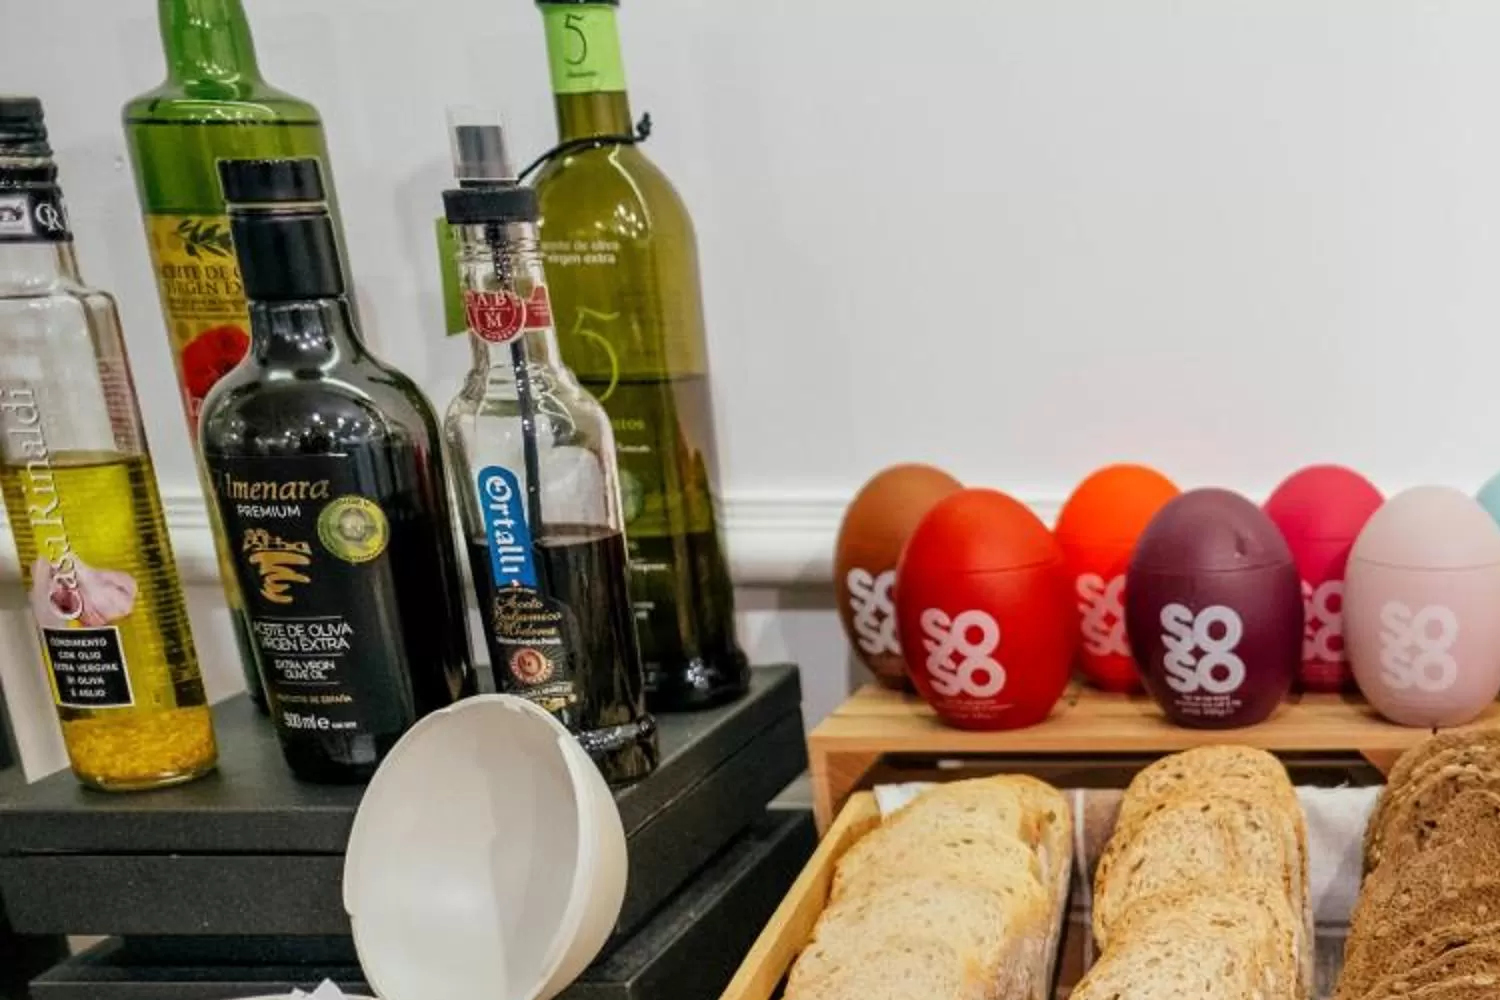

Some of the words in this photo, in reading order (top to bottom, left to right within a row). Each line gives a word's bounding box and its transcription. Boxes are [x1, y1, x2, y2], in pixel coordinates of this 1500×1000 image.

[564, 13, 587, 65] 5
[1, 387, 64, 526] Rinaldi
[223, 473, 331, 501] lmenara
[236, 503, 301, 519] PREMIUM
[485, 475, 526, 574] Ortalli
[45, 534, 83, 619] Casa
[286, 623, 305, 638] DE
[307, 621, 354, 637] OLIVA
[300, 636, 351, 652] EXTRA
